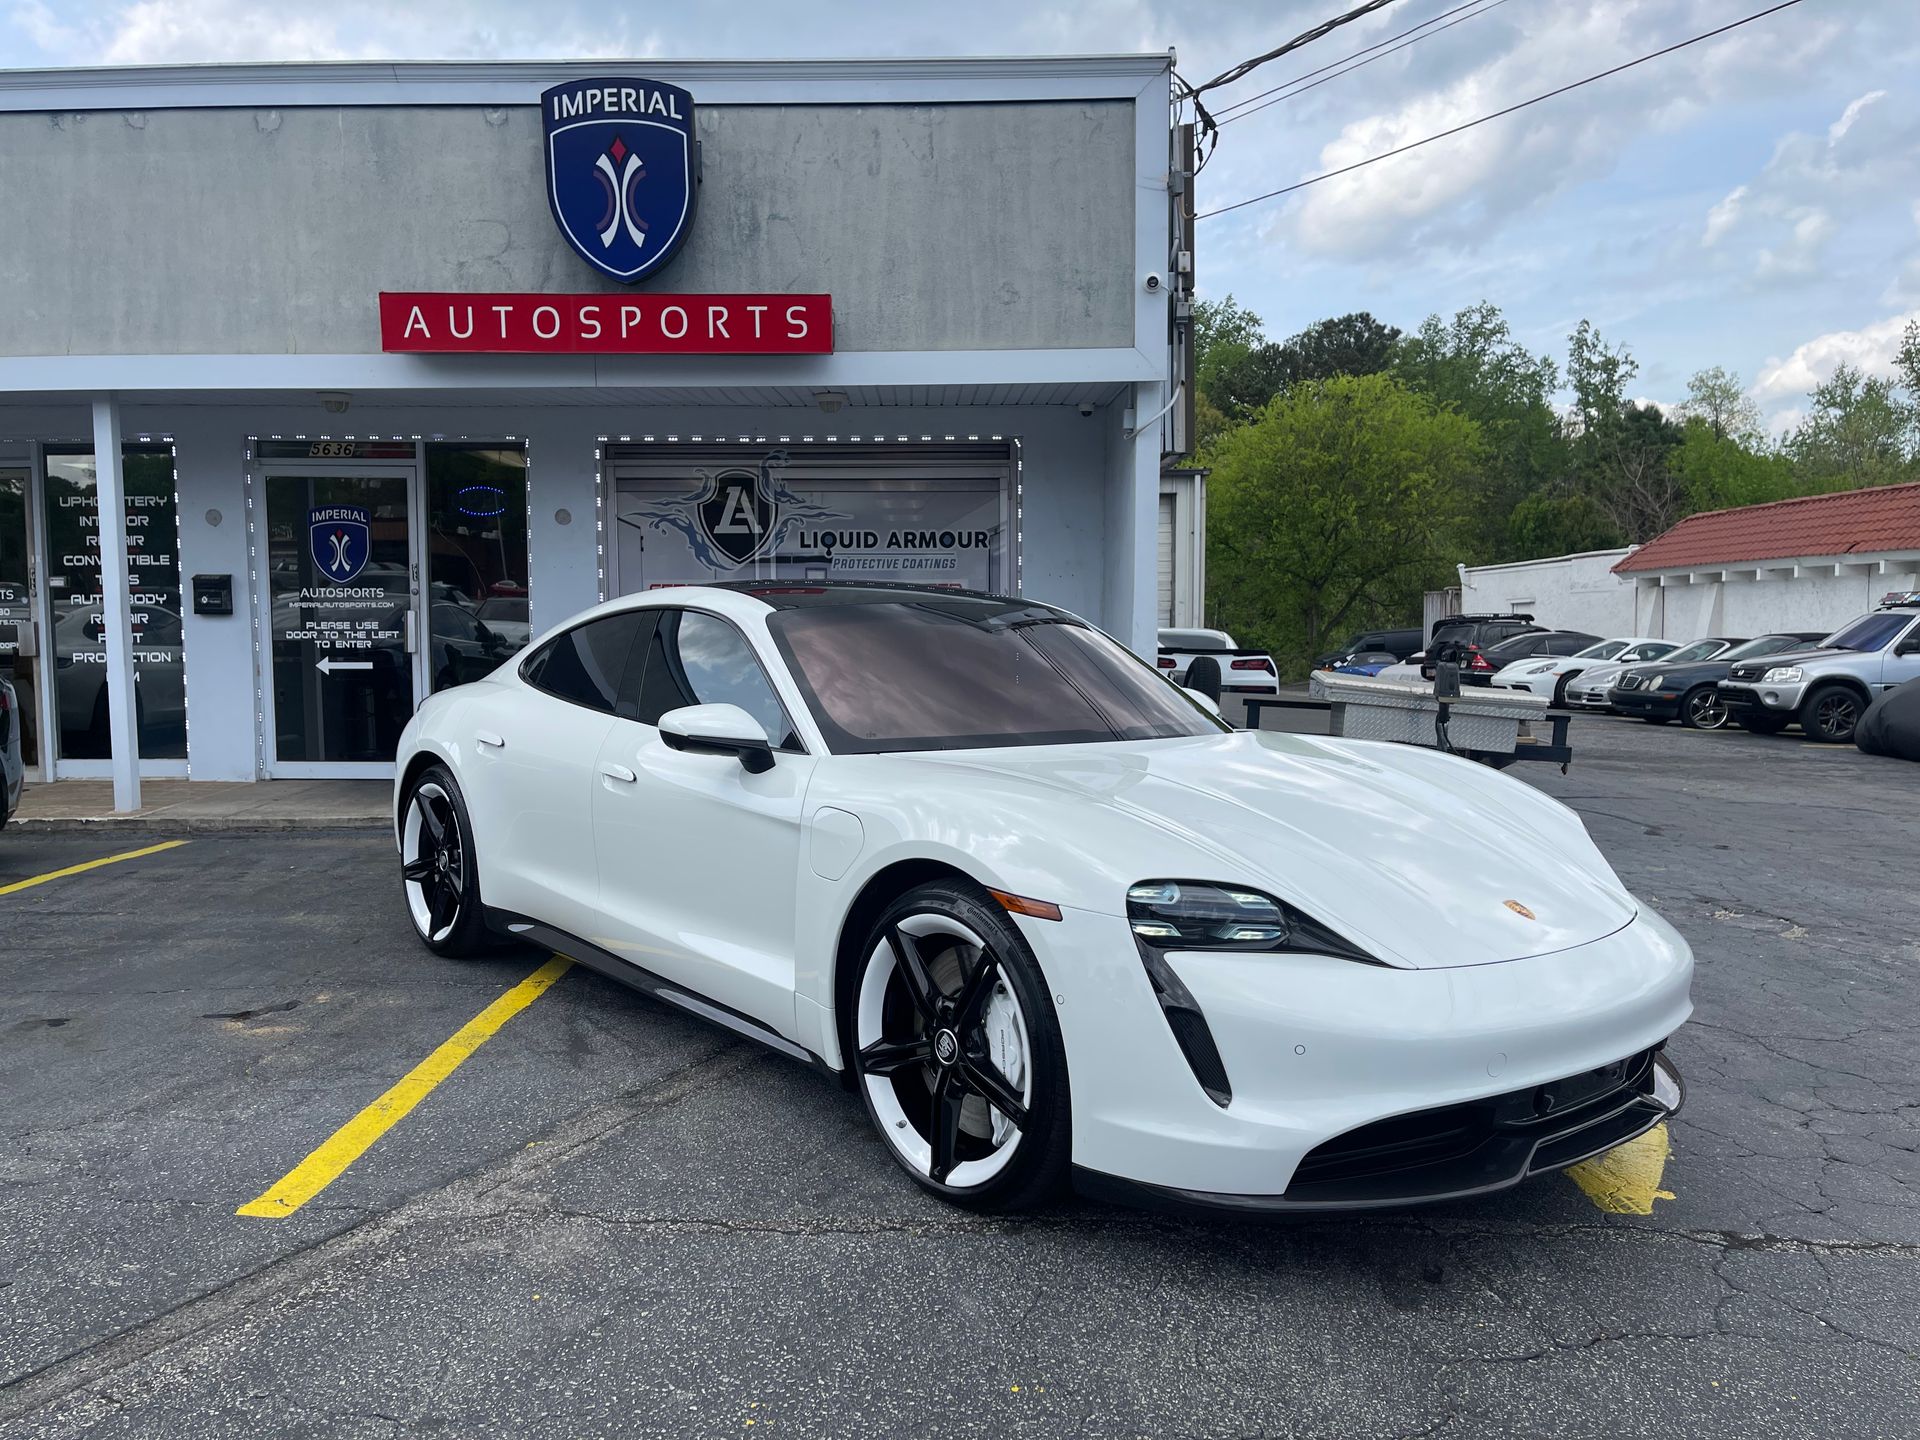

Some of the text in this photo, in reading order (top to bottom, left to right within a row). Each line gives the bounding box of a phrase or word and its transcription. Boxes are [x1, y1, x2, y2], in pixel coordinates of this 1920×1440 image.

[553, 87, 683, 121] IMPERIAL
[403, 306, 809, 339] AUTOSPORTS
[311, 443, 353, 456] 5636
[312, 509, 367, 522] IMPERIAL
[799, 531, 989, 557] LIQUID ARMOUR
[832, 558, 957, 569] PROTECTIVE COATINGS
[300, 588, 385, 598] AUTOSPORTS
[305, 622, 379, 630] PLEASE USE
[286, 631, 400, 639] DOOR TO THE LEFT
[314, 640, 372, 648] TO ENTER
